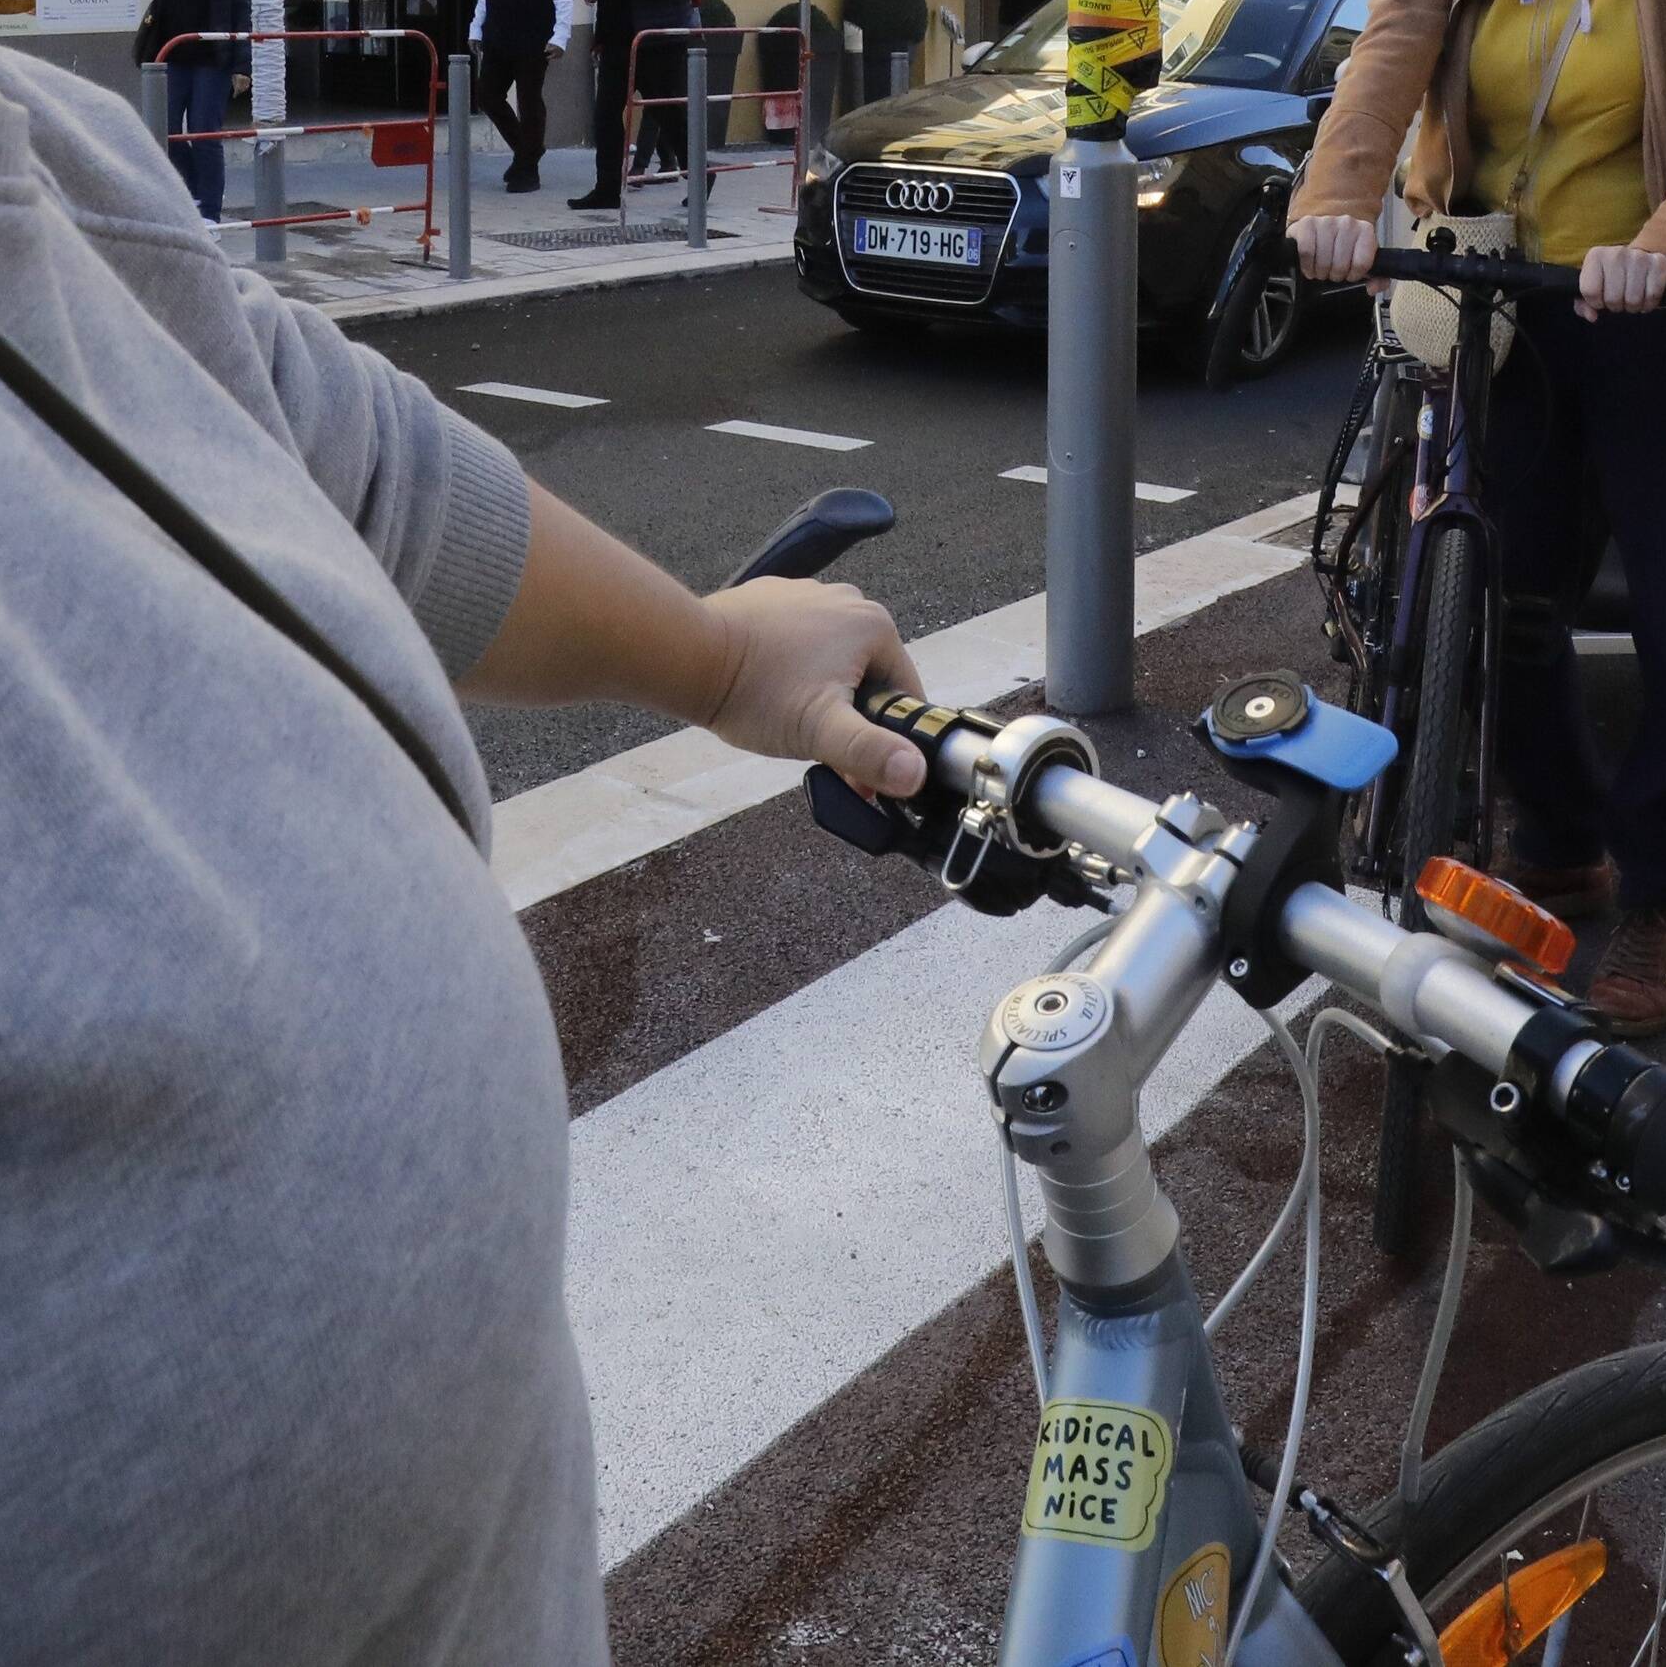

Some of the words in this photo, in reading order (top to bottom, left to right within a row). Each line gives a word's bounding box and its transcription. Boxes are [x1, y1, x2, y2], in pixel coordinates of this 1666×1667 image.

[868, 224, 964, 258] DW-719-HG
[968, 248, 979, 261] 06
[1043, 1453, 1134, 1491] MASS
